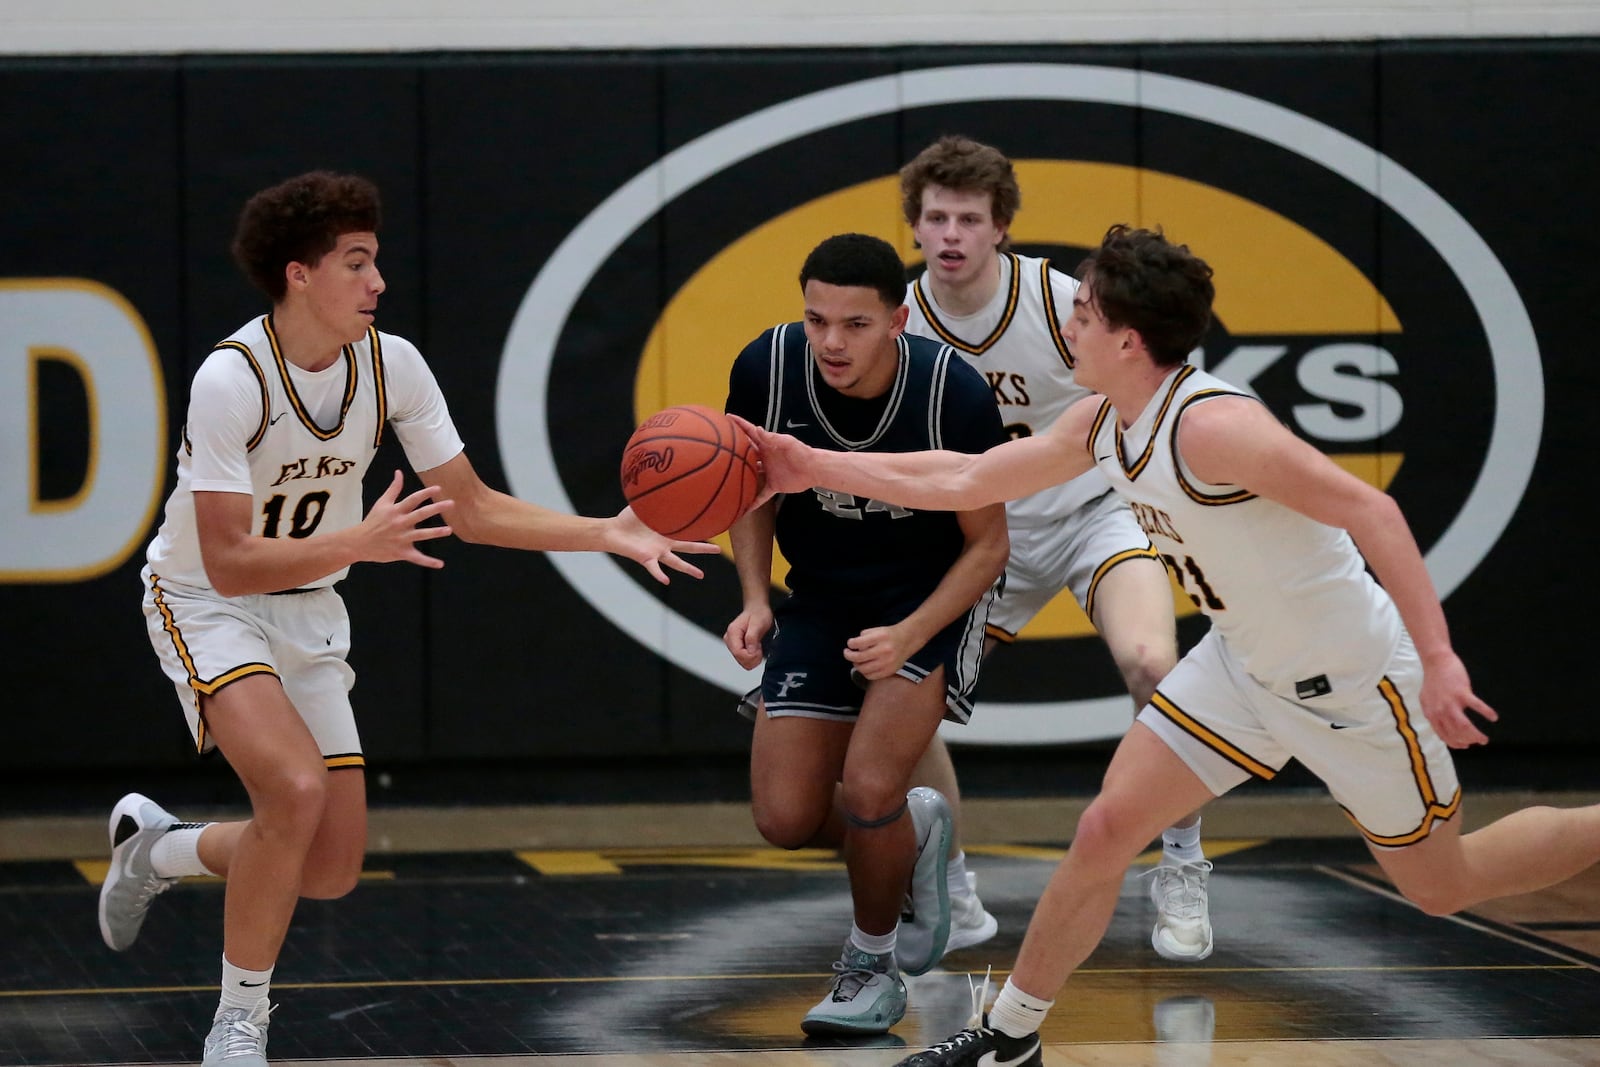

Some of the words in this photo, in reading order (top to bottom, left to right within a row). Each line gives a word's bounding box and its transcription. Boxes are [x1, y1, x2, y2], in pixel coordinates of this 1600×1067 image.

[985, 370, 1031, 407] KS
[1187, 342, 1404, 443] KS
[270, 455, 356, 487] ELKS
[262, 490, 331, 539] 10
[776, 671, 808, 698] F
